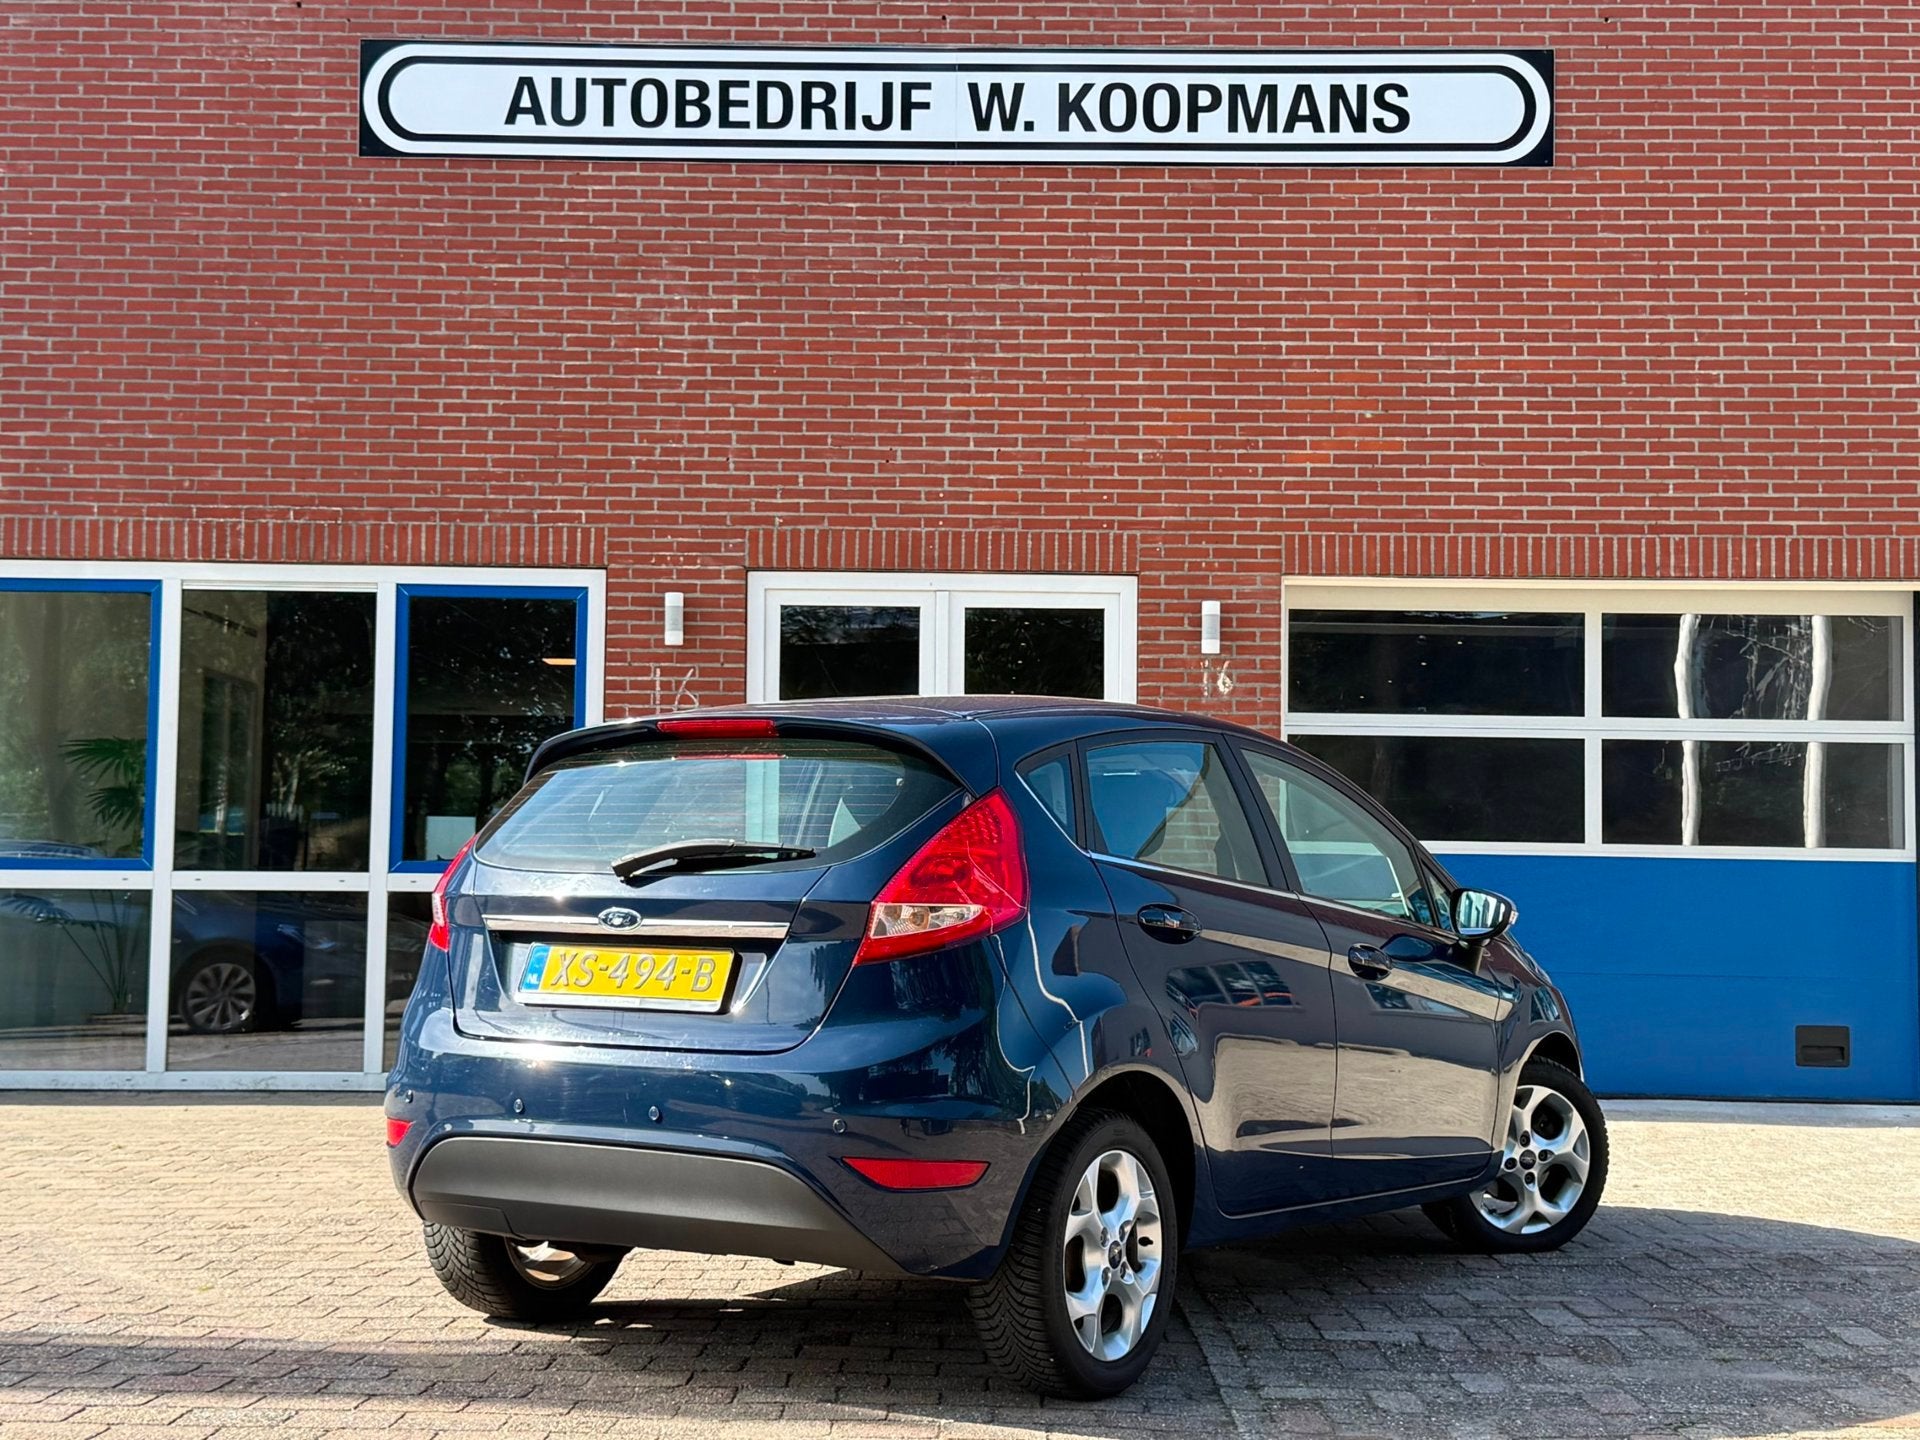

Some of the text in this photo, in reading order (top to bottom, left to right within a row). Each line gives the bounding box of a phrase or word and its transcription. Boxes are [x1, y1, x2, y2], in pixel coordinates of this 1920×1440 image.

[504, 76, 1411, 134] AUTOBEDRIJF W. KOOPMANS
[551, 952, 716, 992] XS-494-B
